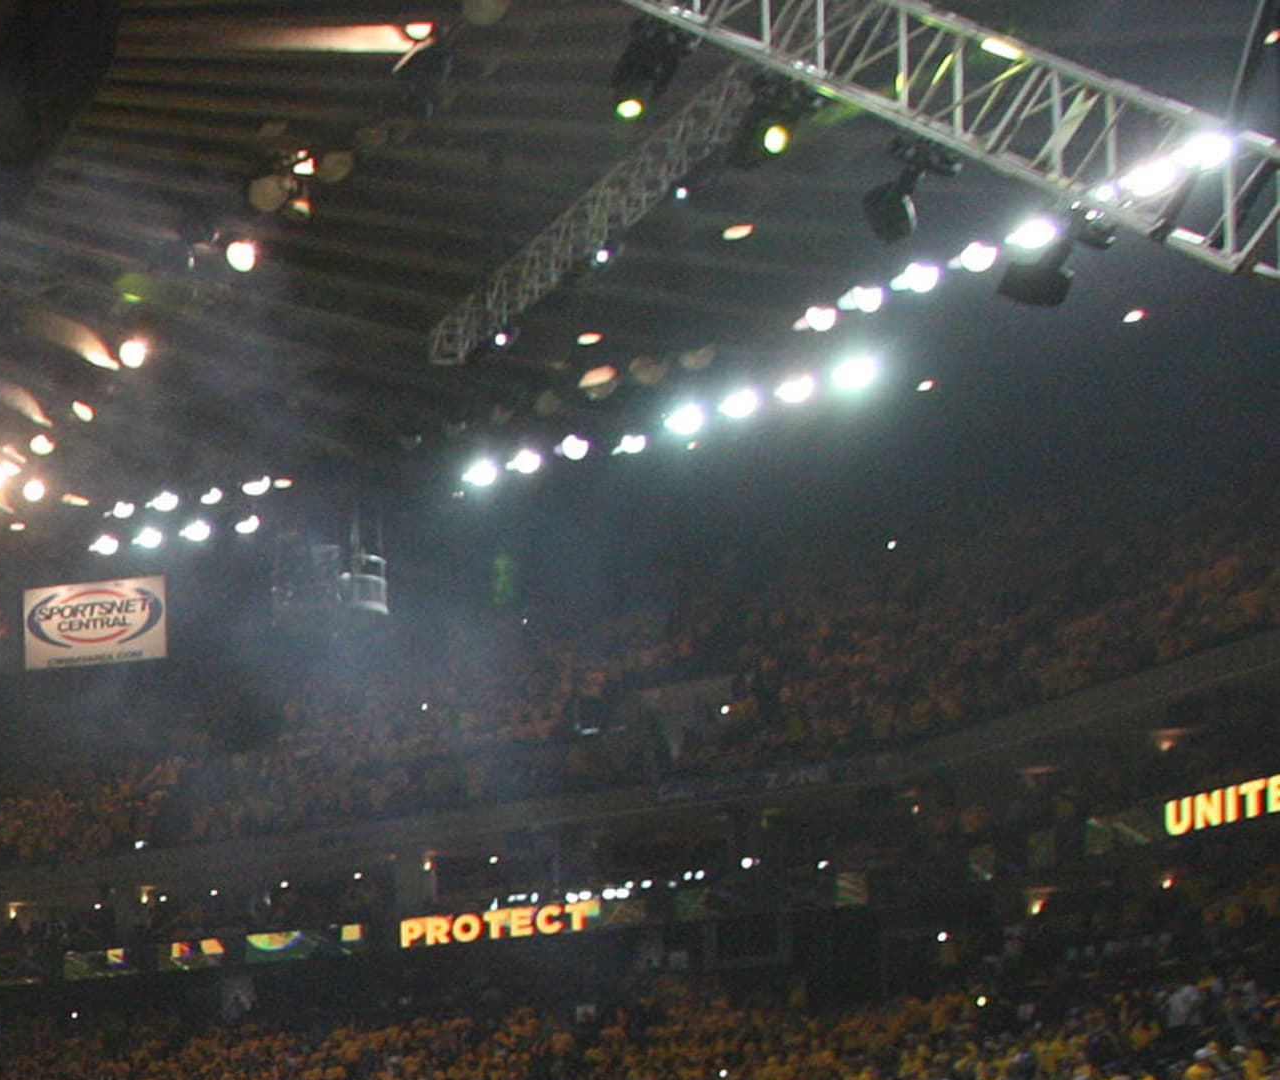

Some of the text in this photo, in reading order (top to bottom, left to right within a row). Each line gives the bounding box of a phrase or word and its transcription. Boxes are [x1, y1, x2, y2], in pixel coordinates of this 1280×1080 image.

[37, 598, 150, 622] SPORTSNET
[57, 616, 130, 632] CENTRAL
[399, 900, 593, 949] PROTECT
